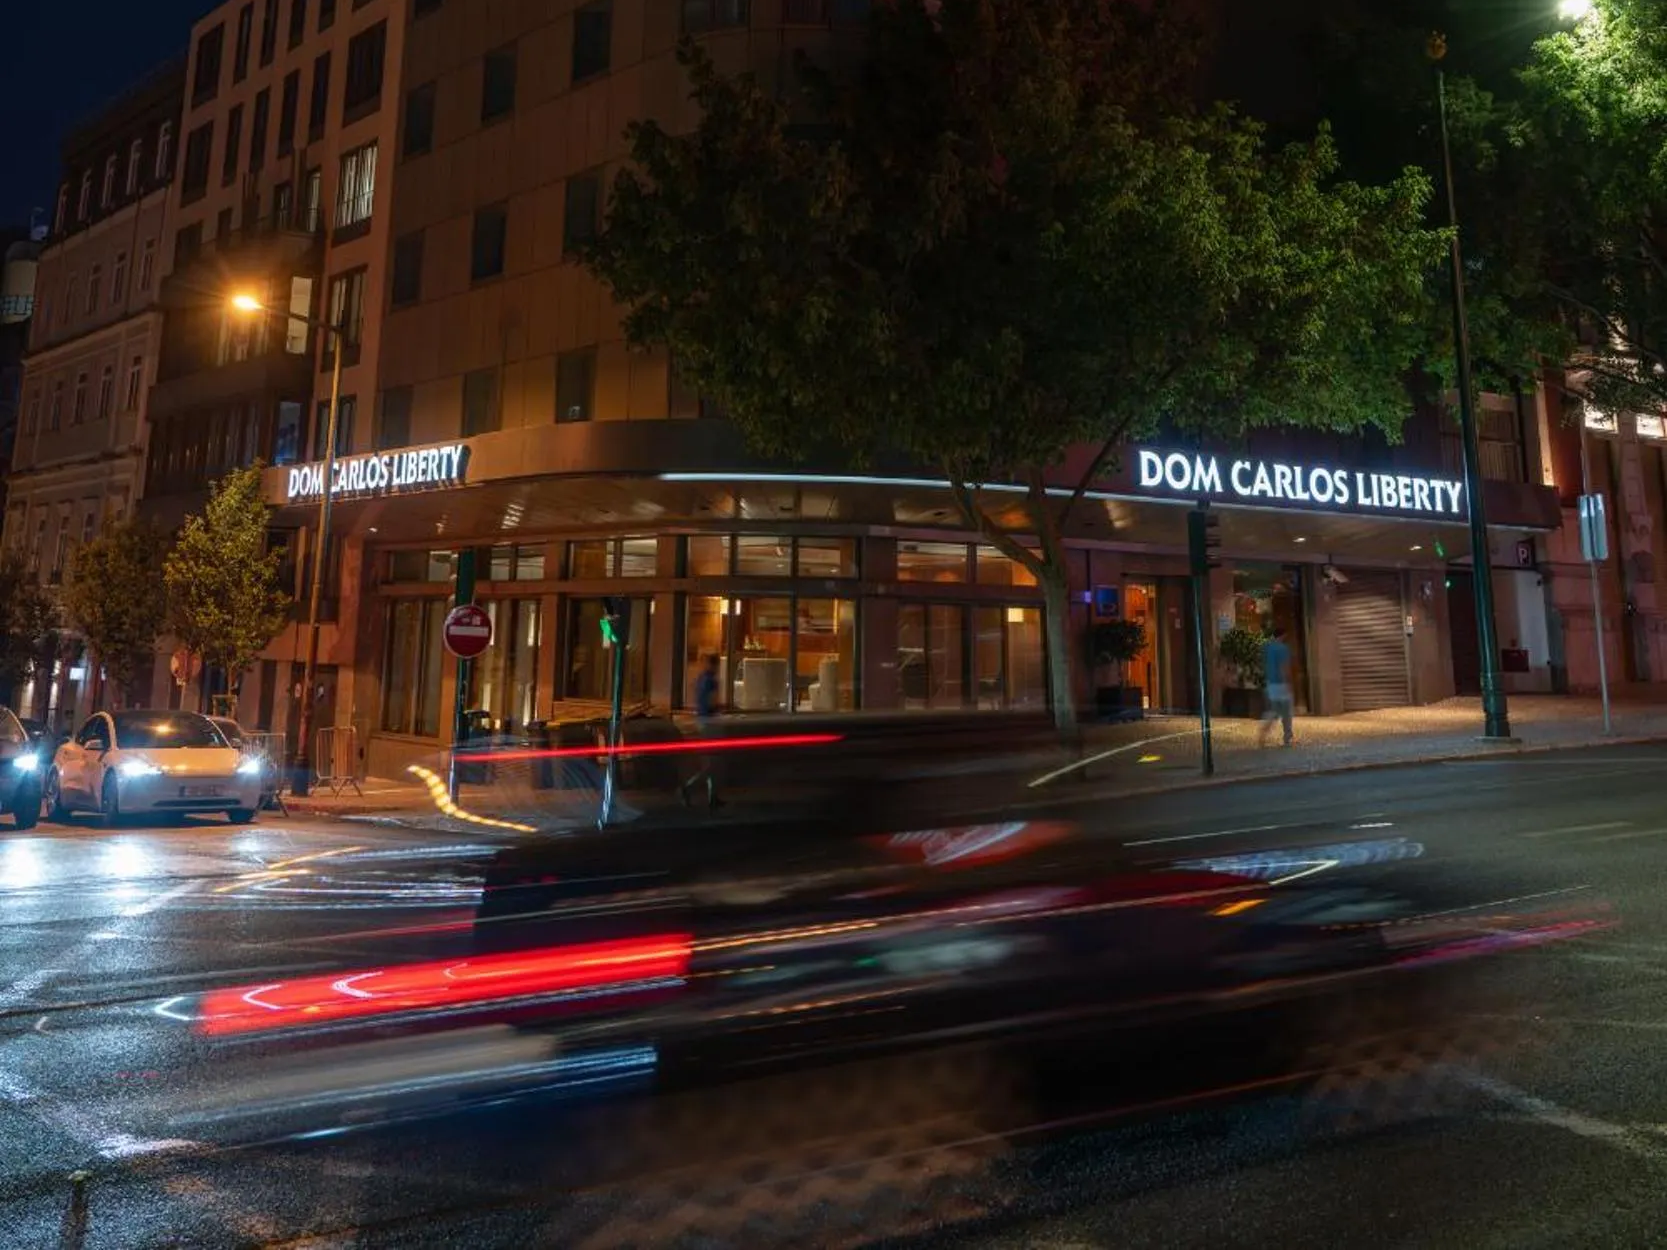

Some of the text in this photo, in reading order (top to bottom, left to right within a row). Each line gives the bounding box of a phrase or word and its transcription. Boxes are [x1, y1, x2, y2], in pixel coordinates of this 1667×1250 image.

[288, 465, 325, 497] DOM
[391, 444, 463, 485] LIBERTY
[1139, 450, 1462, 513] DOM CARLOS LIBERTY
